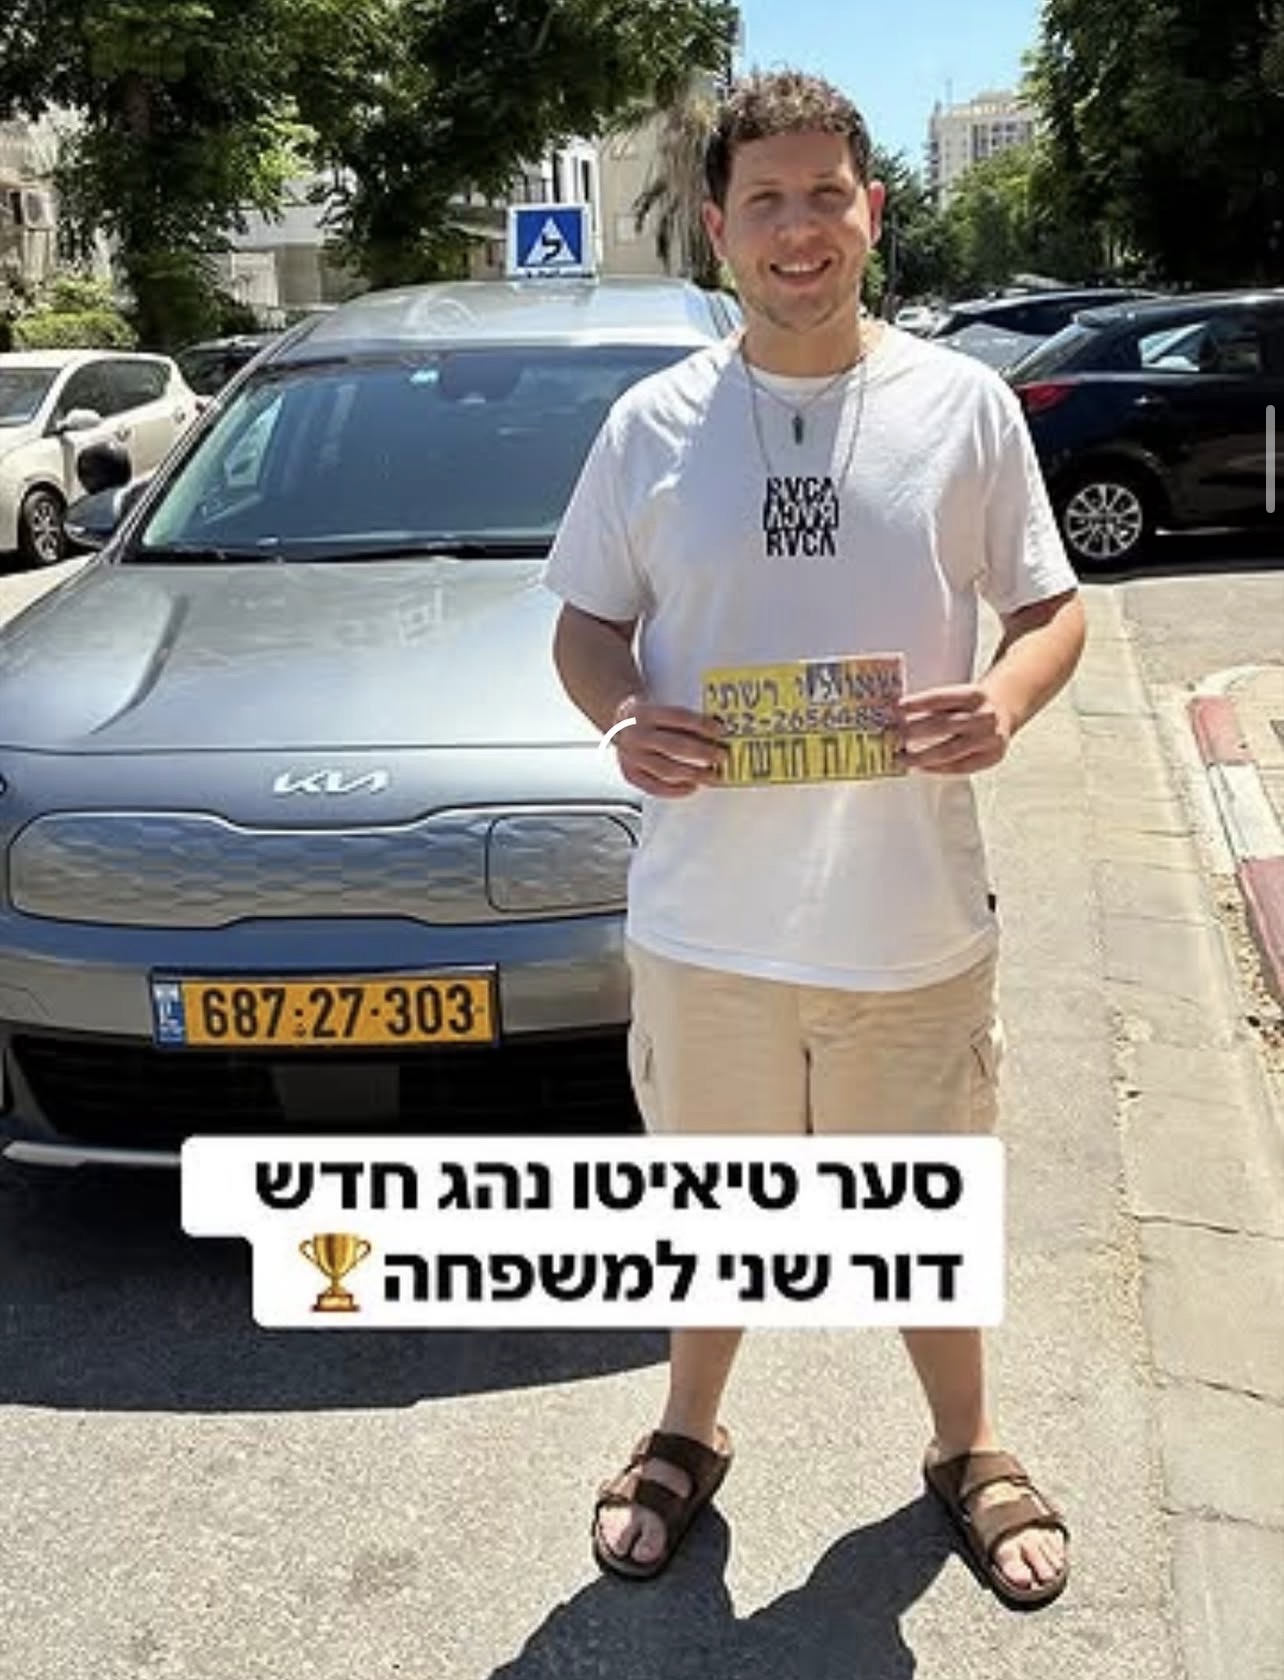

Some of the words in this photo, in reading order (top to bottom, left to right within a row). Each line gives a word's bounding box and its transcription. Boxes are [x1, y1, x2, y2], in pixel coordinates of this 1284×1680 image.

[542, 234, 561, 264] ל
[766, 477, 836, 503] RVCA
[766, 528, 836, 556] RVCA
[273, 769, 388, 793] KIA
